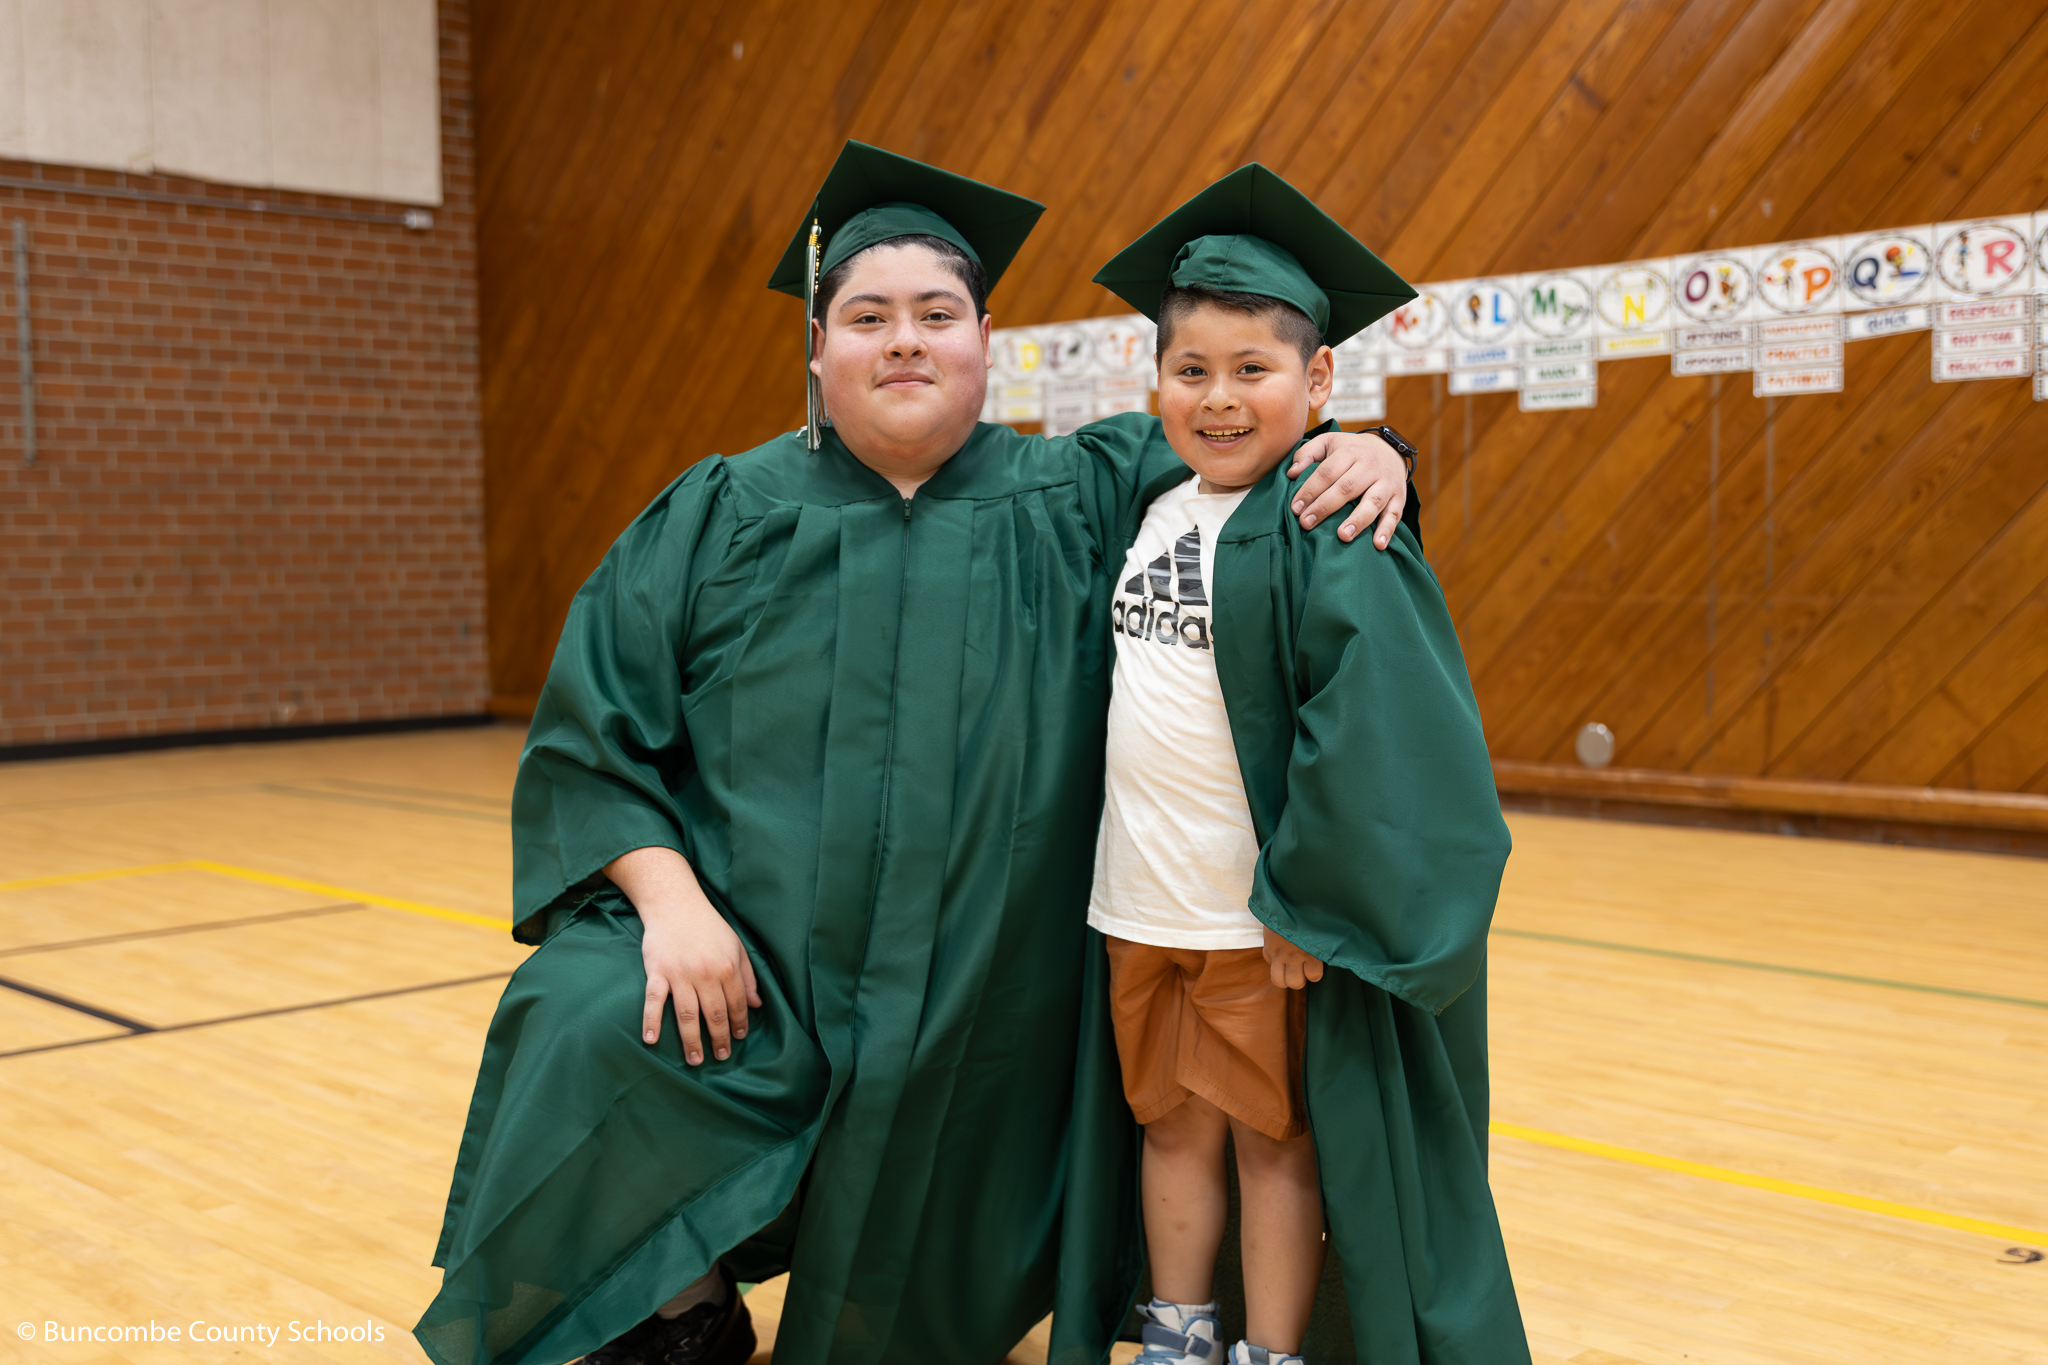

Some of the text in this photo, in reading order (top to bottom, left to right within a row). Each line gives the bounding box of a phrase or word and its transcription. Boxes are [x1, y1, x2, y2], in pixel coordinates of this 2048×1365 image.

[1854, 257, 1880, 289] Q
[1982, 240, 2015, 276] R
[1684, 270, 1710, 303] O
[1802, 266, 1832, 301] P
[1493, 293, 1507, 325] L
[1531, 286, 1558, 316] M
[1622, 293, 1645, 325] N
[1392, 307, 1410, 334] K
